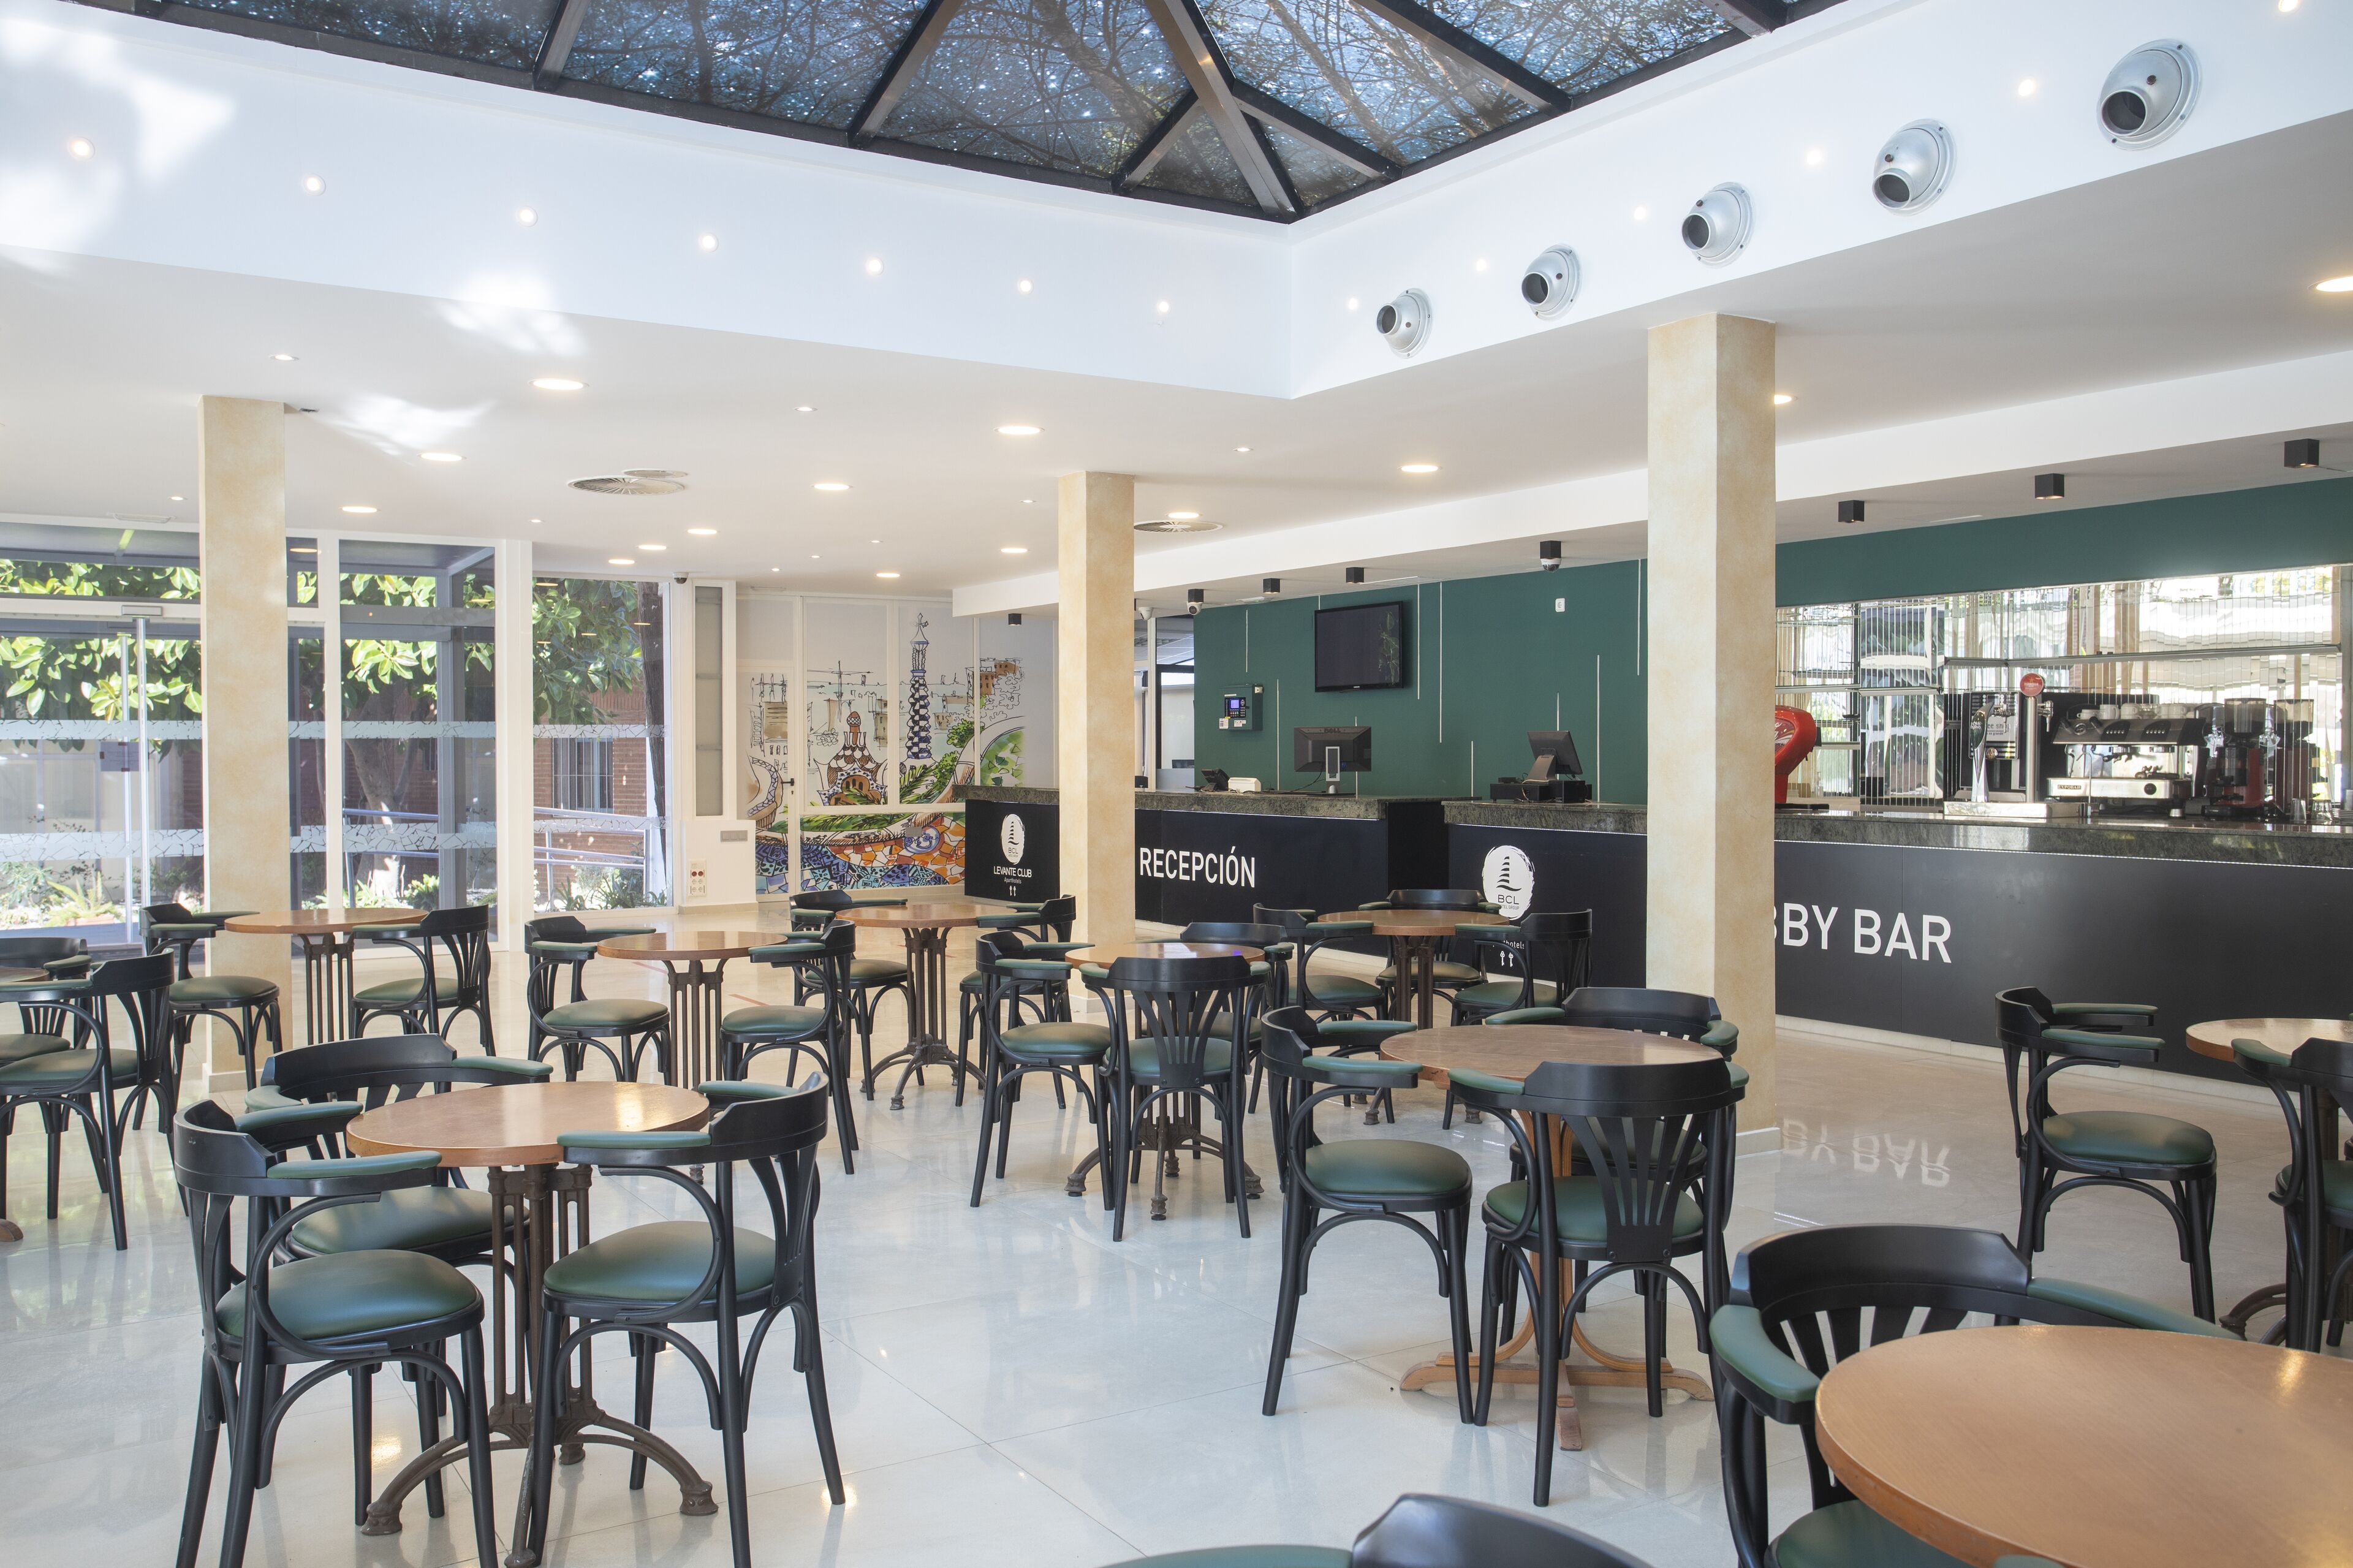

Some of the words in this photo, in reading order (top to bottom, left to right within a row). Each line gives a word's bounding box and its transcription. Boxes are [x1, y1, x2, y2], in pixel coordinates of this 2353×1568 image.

[993, 866, 1017, 876] LEVANTE
[1017, 868, 1032, 878] CLUB
[1140, 846, 1255, 888] RECEPCIÓN
[1498, 894, 1520, 905] BCL
[1774, 903, 1838, 950] BY
[1854, 909, 1952, 963] BAR
